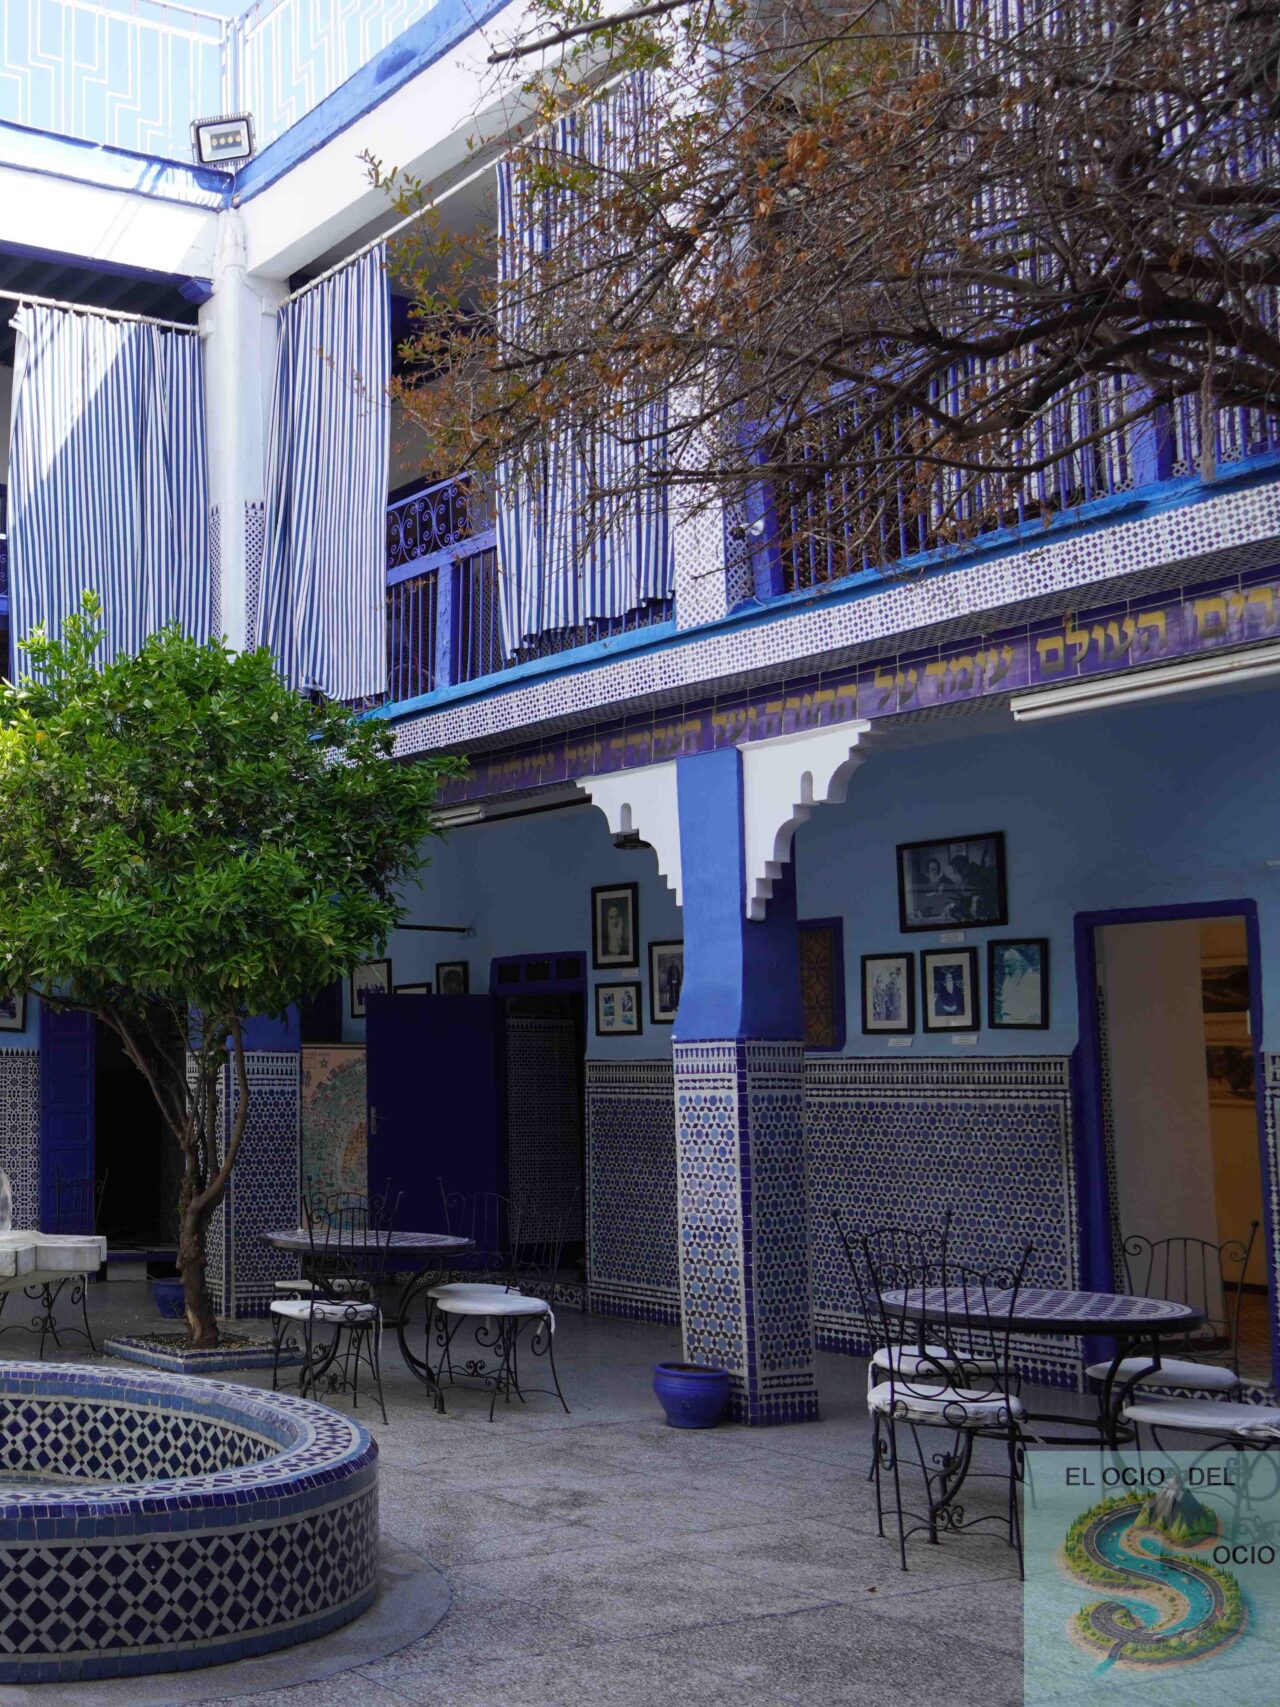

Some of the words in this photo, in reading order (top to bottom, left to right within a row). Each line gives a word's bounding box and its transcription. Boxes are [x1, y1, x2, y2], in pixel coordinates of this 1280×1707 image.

[1193, 587, 1280, 638] רים
[1035, 609, 1169, 675] העולם
[874, 665, 918, 711] על
